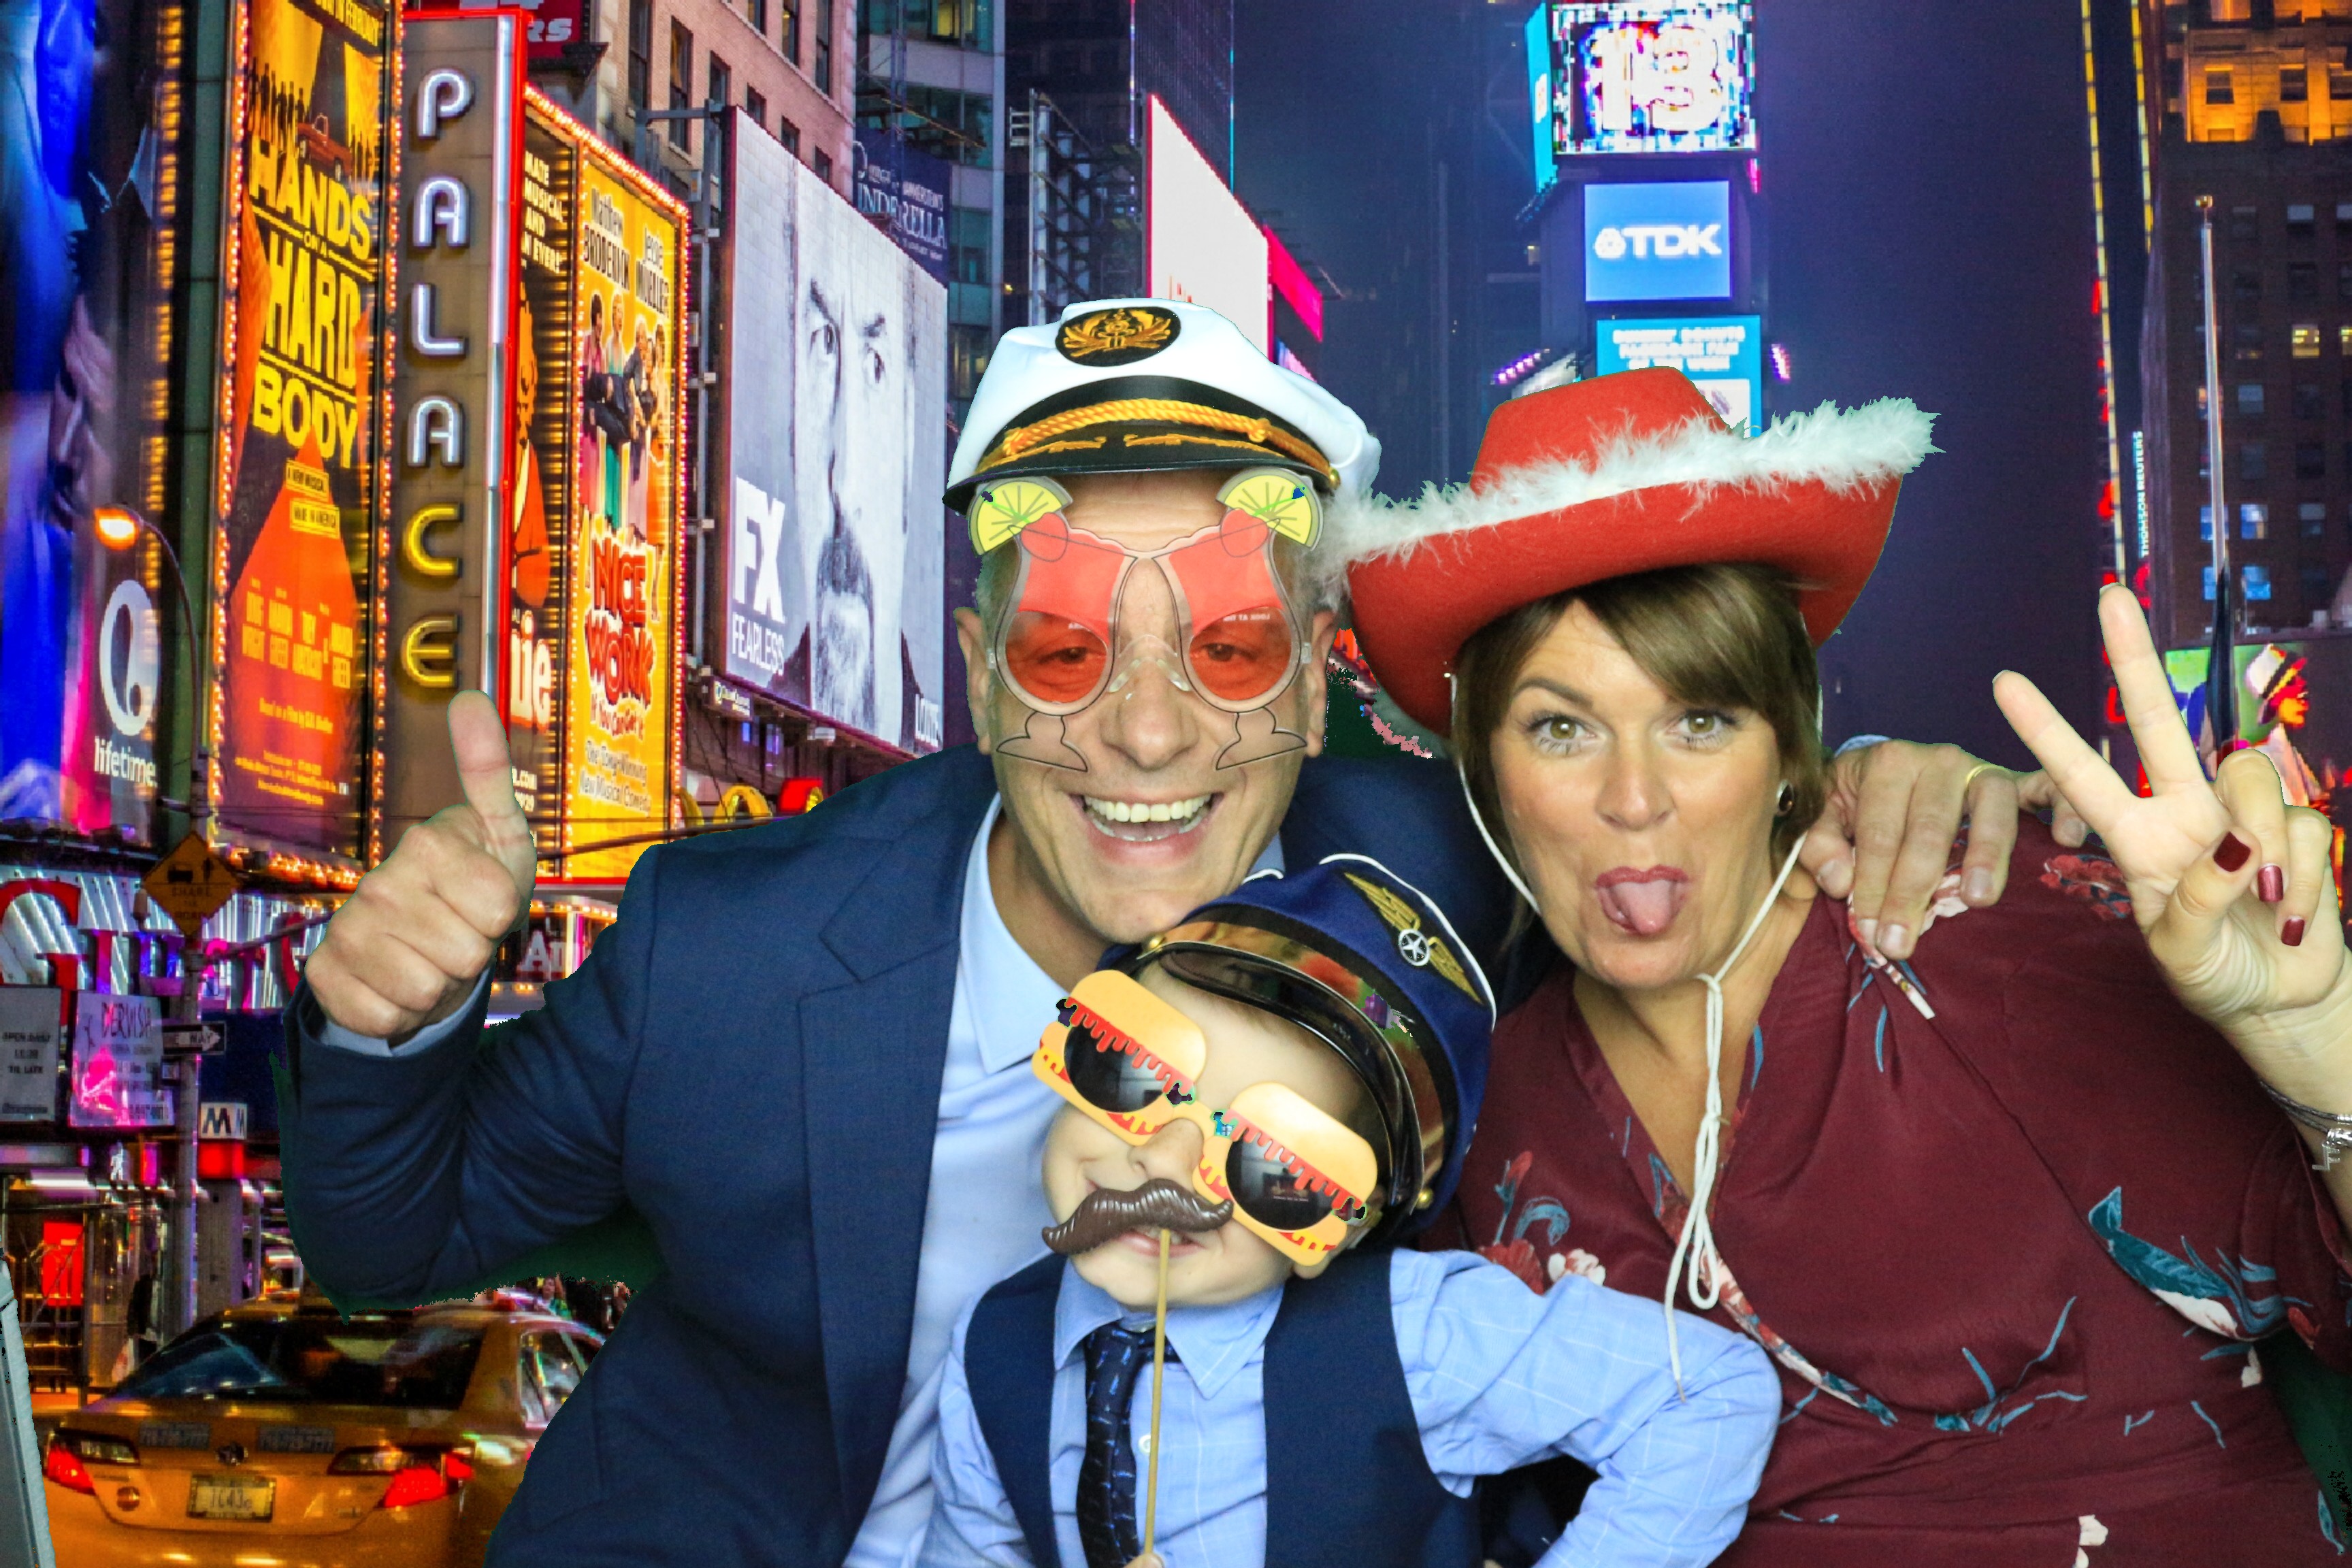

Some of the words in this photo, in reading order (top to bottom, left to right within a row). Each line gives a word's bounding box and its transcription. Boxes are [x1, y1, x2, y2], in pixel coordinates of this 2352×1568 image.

[248, 138, 373, 261] HANDS
[1622, 224, 1722, 258] TDK
[265, 240, 362, 390] HARD
[252, 361, 359, 469] BODY
[402, 67, 476, 687] PALACE
[592, 536, 647, 626] NICE
[734, 474, 785, 625] FX
[585, 612, 655, 710] WORK
[732, 611, 785, 676] FEARLESS
